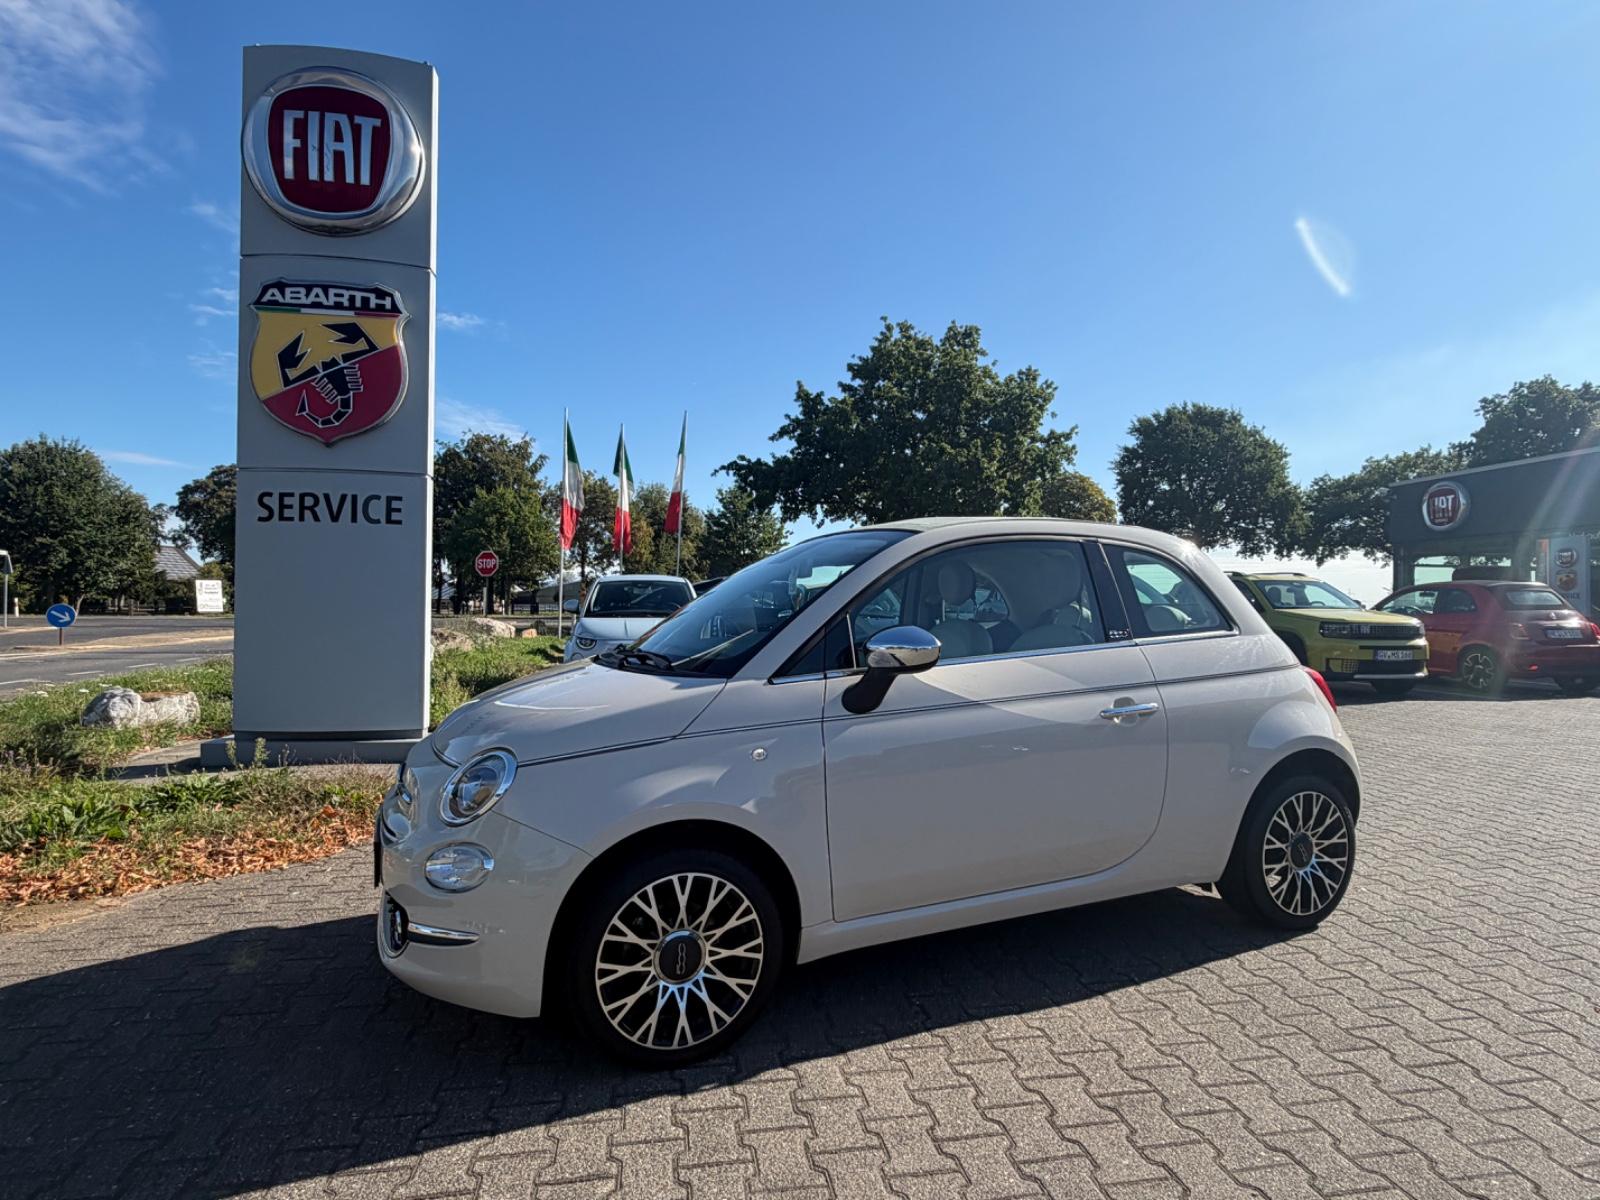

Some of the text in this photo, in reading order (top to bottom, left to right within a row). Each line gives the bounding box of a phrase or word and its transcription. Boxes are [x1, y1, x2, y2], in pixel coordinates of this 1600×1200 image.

[282, 109, 382, 186] FIAT
[260, 286, 392, 310] ABARTH
[256, 491, 403, 526] SERVICE
[476, 558, 496, 569] STOP
